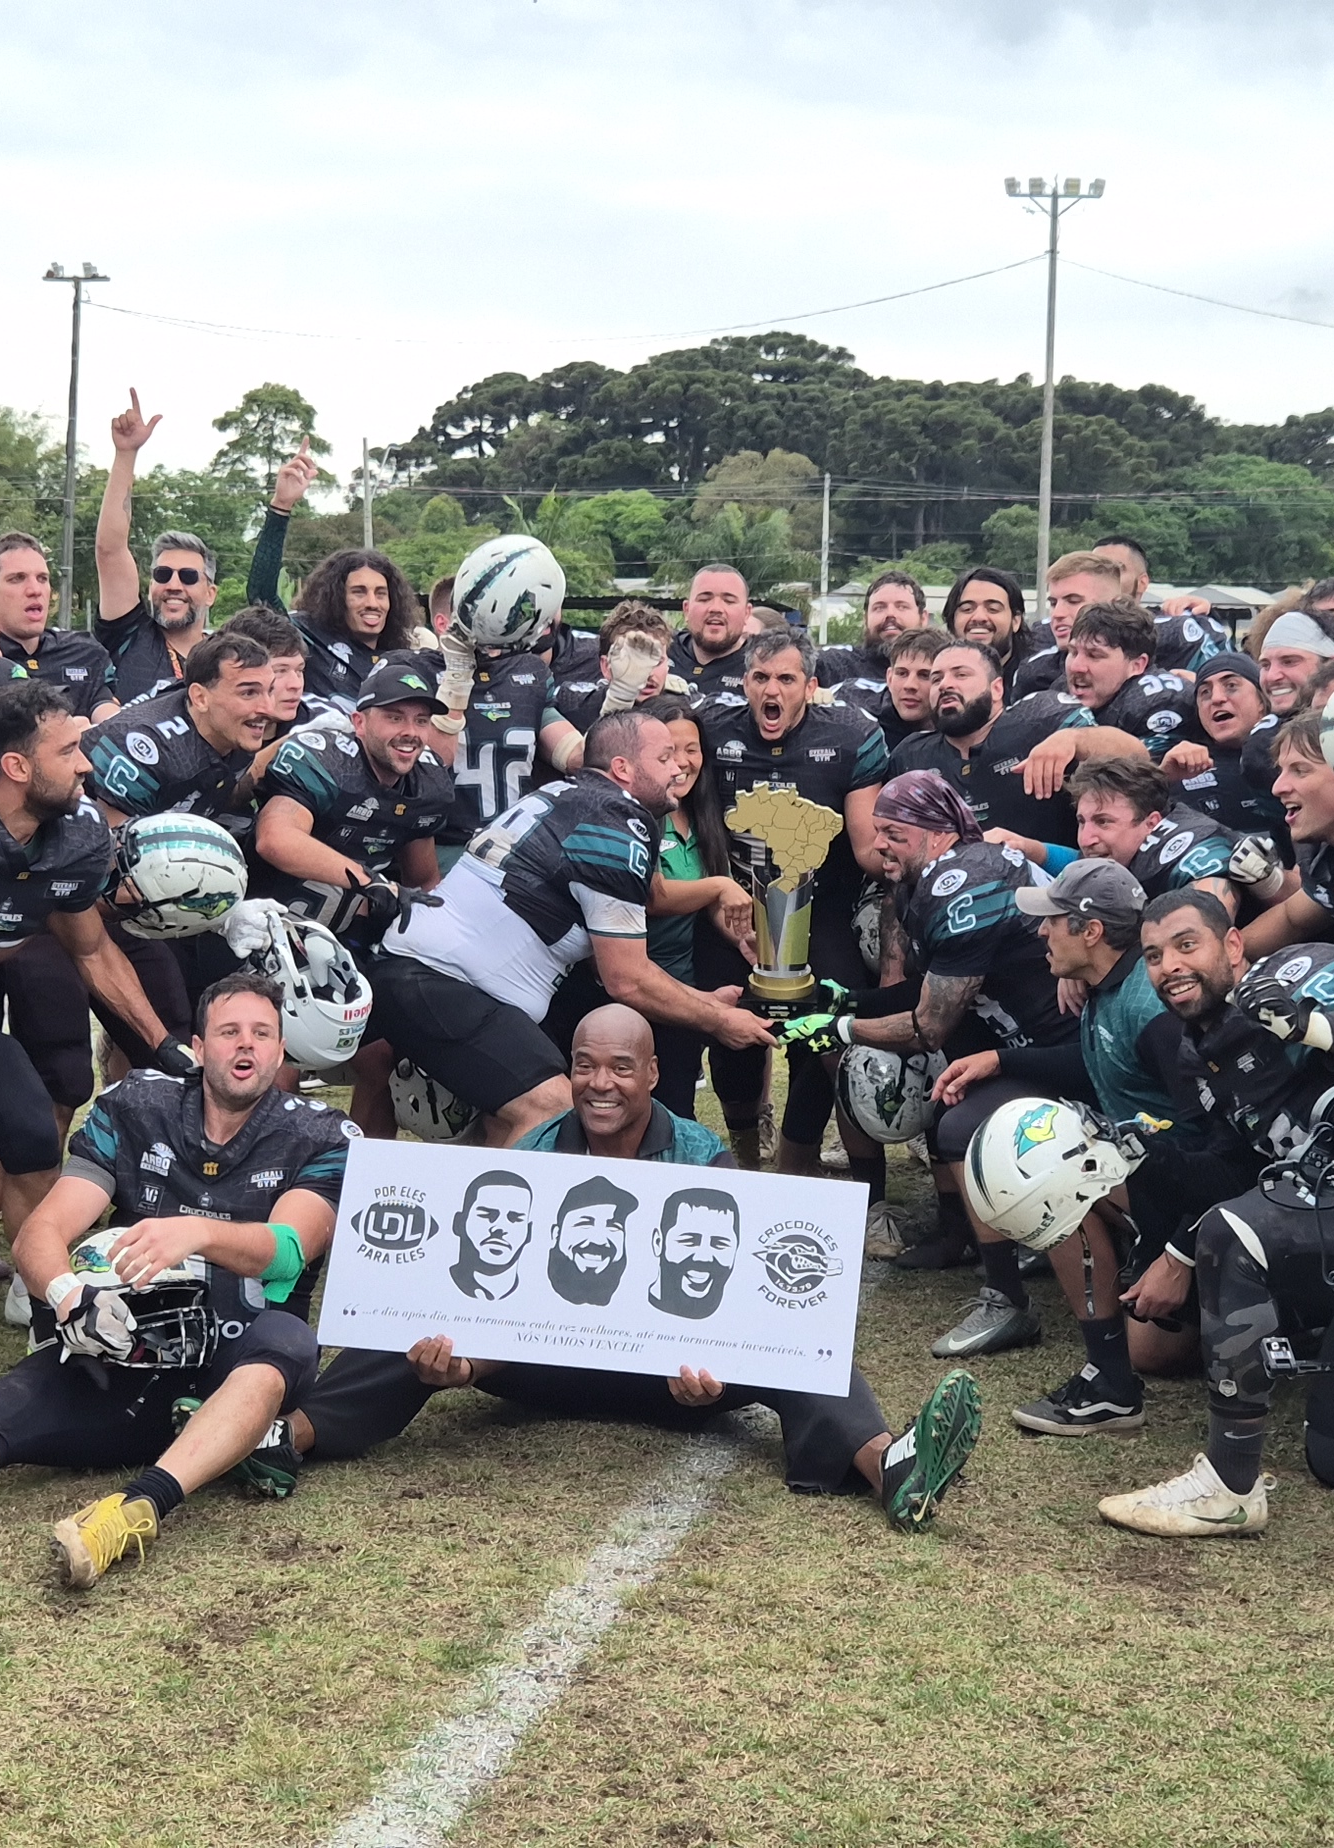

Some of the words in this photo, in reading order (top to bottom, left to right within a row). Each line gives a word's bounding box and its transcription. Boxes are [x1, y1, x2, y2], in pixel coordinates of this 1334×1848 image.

[142, 1151, 171, 1170] ARBO
[374, 1185, 397, 1199] POR
[400, 1186, 426, 1203] ELES
[367, 1210, 423, 1242] LDL
[758, 1220, 839, 1253] CROCODILES
[357, 1243, 390, 1265] PARA
[396, 1247, 426, 1265] ELES
[757, 1284, 829, 1310] FOREVER
[381, 1306, 399, 1318] dia
[401, 1308, 427, 1322] após
[429, 1310, 450, 1323] dia,
[453, 1314, 473, 1324] nos
[475, 1315, 526, 1329] tornamos
[529, 1320, 556, 1331] cada
[580, 1325, 633, 1339] melhores,
[636, 1331, 655, 1340] até
[657, 1333, 677, 1343] nos
[679, 1334, 739, 1349] tornarmos
[741, 1340, 808, 1358] invencíveis.
[514, 1330, 541, 1343] NÓS
[543, 1334, 586, 1348] VAMOS
[588, 1338, 646, 1354] VENCER!
